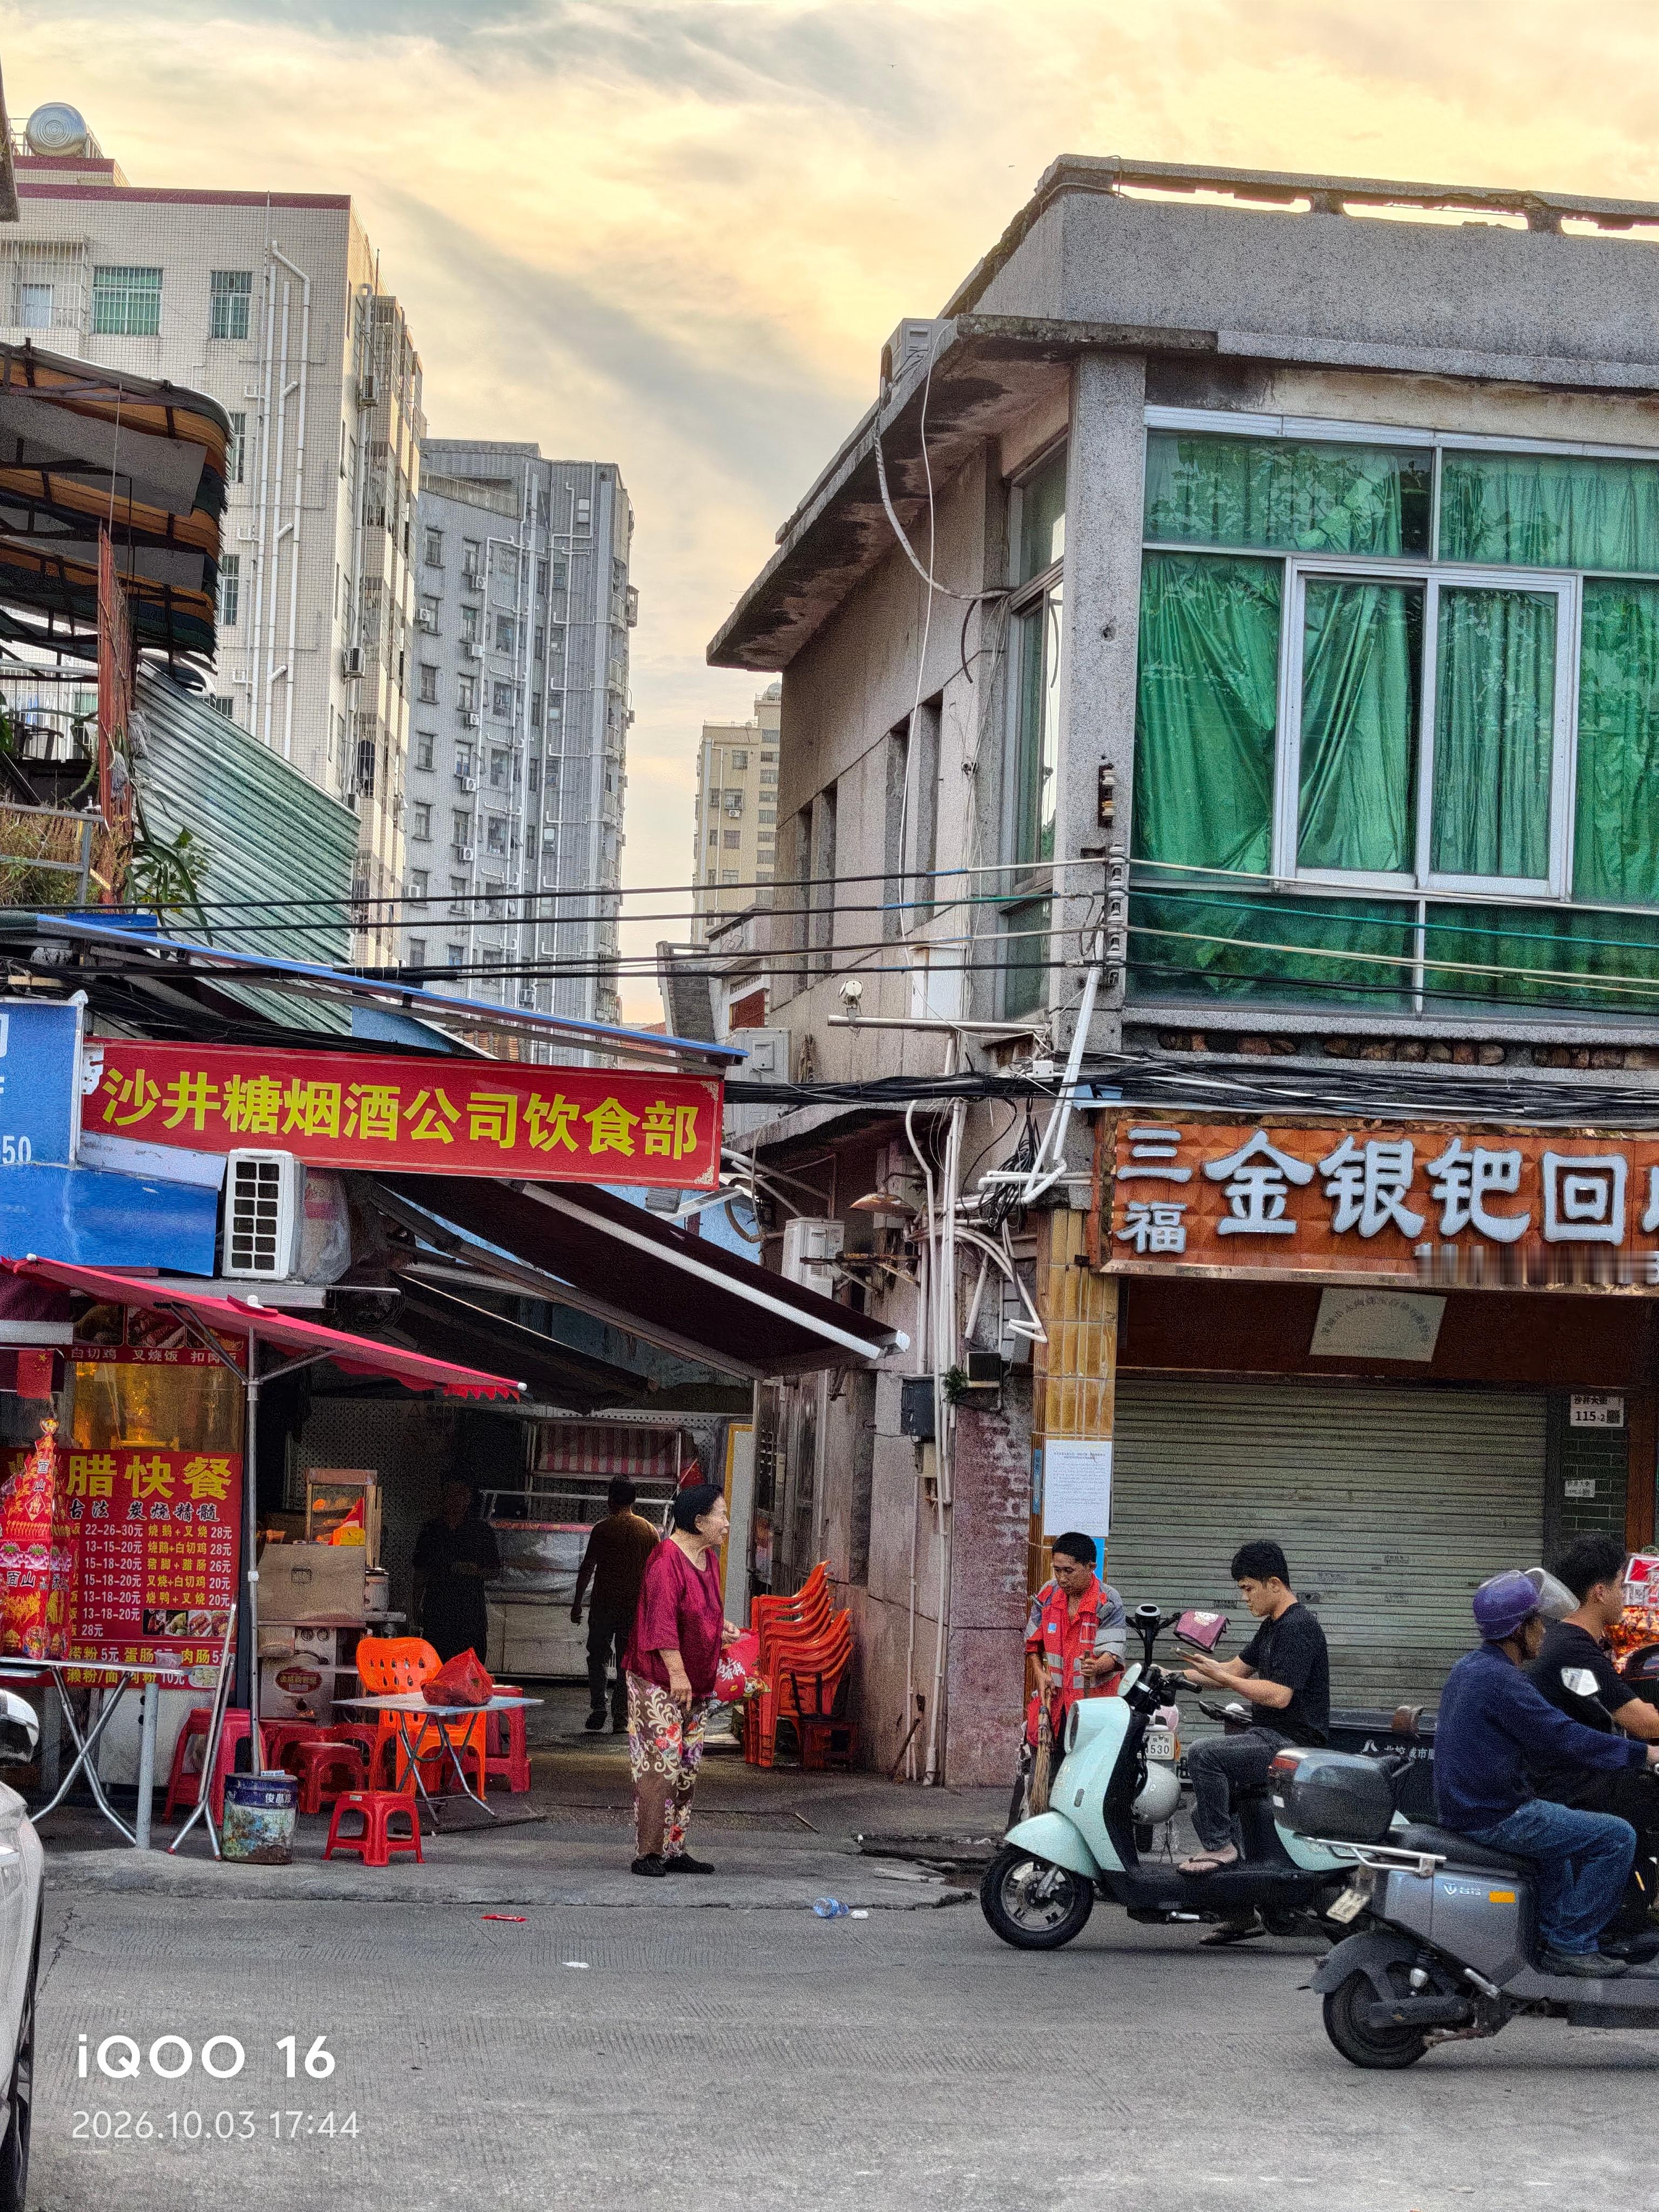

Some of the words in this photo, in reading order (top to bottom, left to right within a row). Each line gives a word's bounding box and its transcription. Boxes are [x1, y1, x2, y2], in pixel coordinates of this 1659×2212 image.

[102, 1068, 698, 1161] 沙井糖烟酒公司饮食部
[1203, 1128, 1659, 1246] 金银钯回
[8, 1453, 232, 1501] 腊快餐
[85, 1523, 144, 1537] 22-26-30元
[211, 1526, 232, 1540] 28元
[85, 1541, 143, 1554] 13-15-20元
[210, 1543, 232, 1556] 28元
[84, 1557, 143, 1571] 15-18-20元
[209, 1560, 232, 1574] 26元
[84, 1574, 142, 1588] 15-18-20元
[208, 1576, 231, 1590] 20元
[83, 1592, 141, 1605] 13-18-20元
[208, 1594, 231, 1607] 20元
[82, 1609, 140, 1621] 13-18-20元
[81, 1624, 104, 1636] 28元
[181, 1648, 210, 1664] 肉肠
